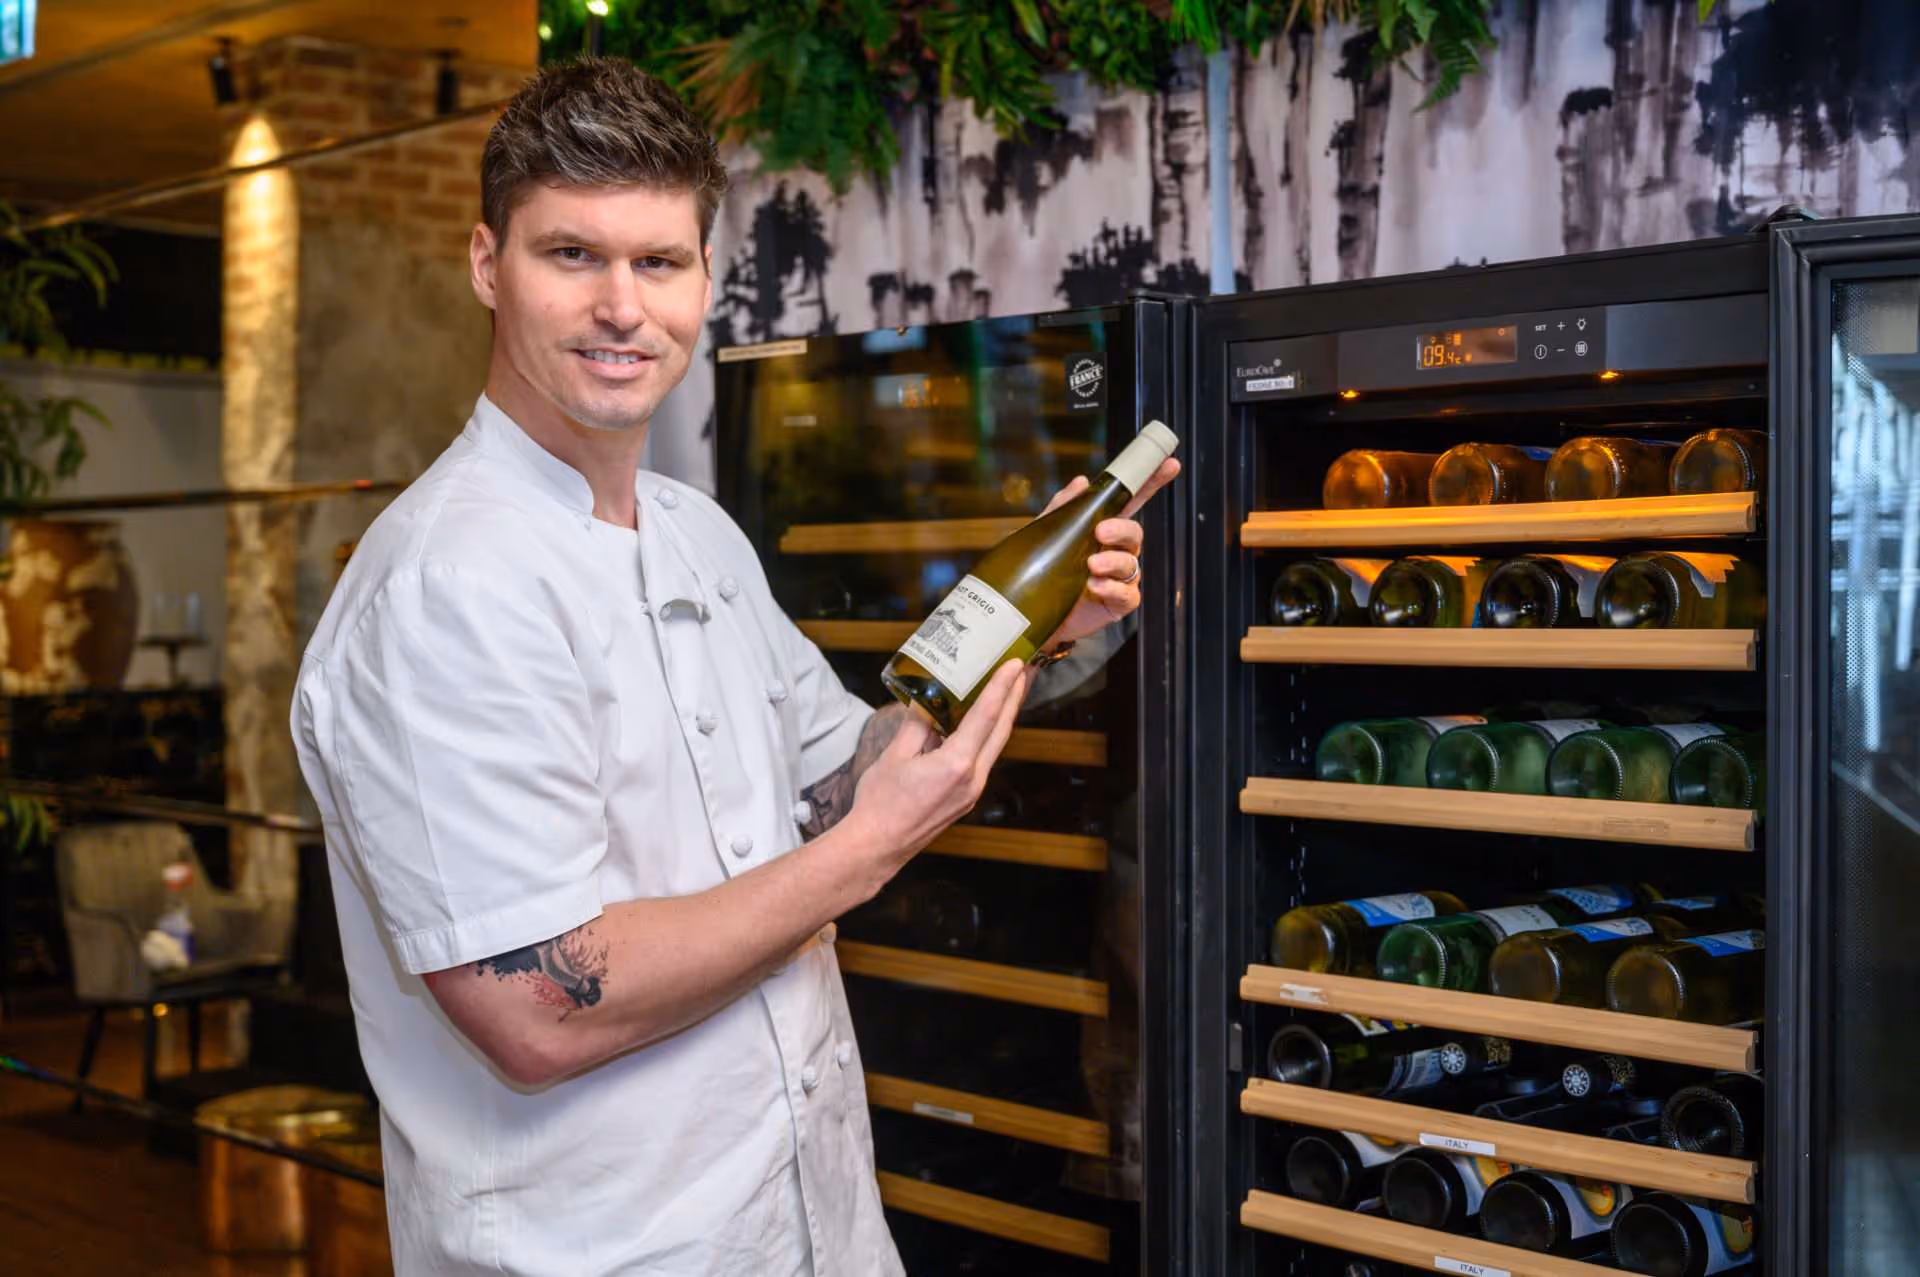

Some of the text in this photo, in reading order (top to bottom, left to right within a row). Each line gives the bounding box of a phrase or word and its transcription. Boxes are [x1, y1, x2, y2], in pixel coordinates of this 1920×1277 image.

[1070, 368, 1101, 388] FRANCE
[967, 591, 995, 615] GRIGIO
[1445, 1138, 1469, 1149] ITALY
[1460, 1263, 1484, 1277] ITALY
